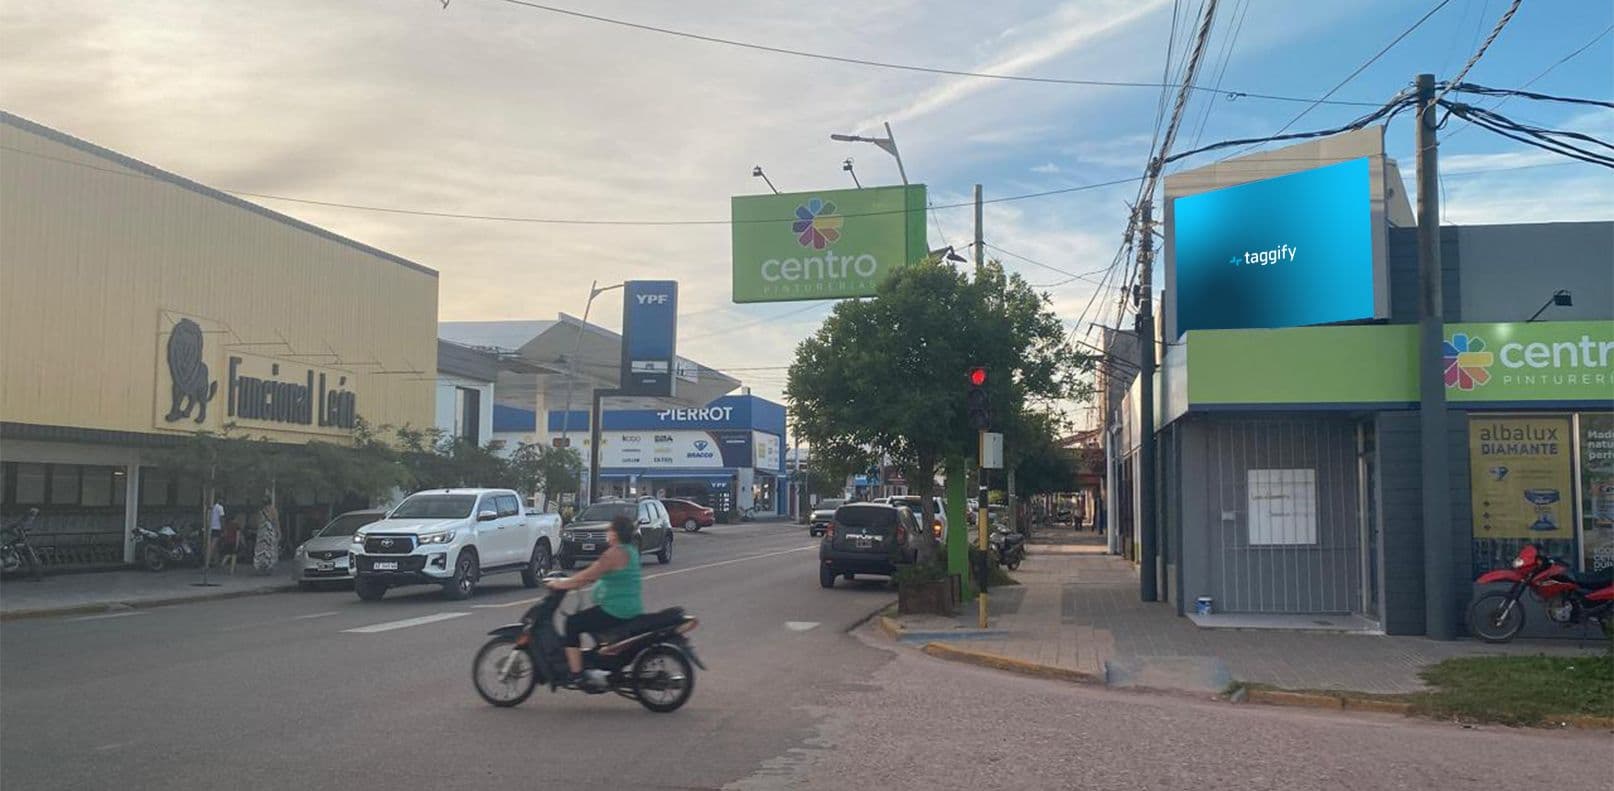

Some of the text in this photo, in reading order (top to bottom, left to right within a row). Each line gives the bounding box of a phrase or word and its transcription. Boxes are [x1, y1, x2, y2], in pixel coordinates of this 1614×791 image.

[1244, 243, 1297, 266] taggify
[761, 250, 877, 282] centro
[636, 294, 669, 305] YPF
[228, 356, 356, 429] Funcional León
[657, 406, 733, 421] PIERROT
[1480, 424, 1559, 441] albalux
[1481, 443, 1559, 456] DIAMANTE
